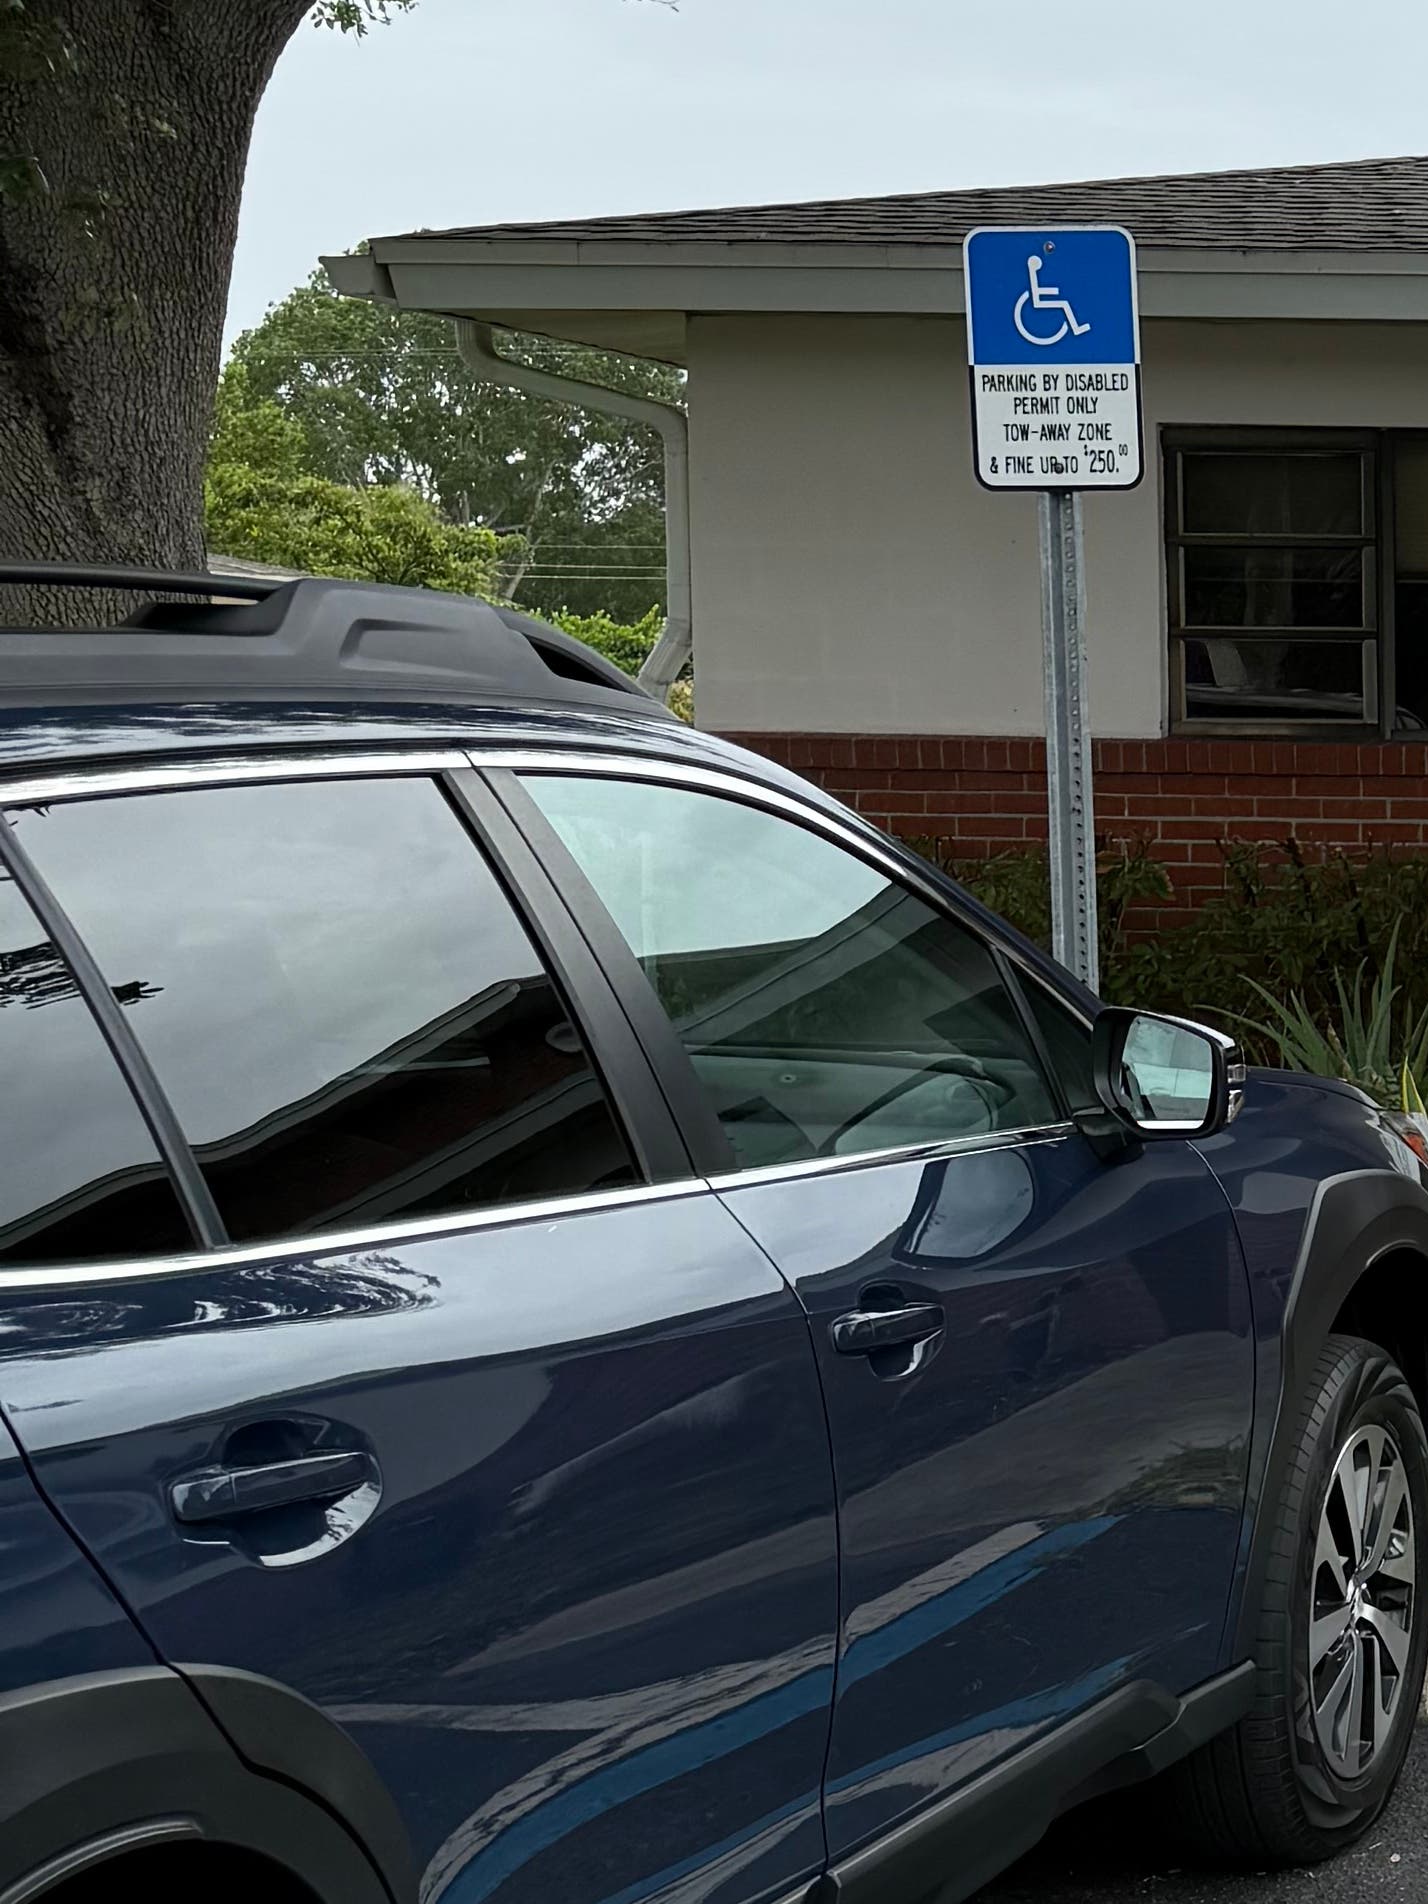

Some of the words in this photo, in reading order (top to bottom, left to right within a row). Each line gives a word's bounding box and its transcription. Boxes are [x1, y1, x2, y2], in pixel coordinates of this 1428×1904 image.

[982, 374, 1037, 392] PARKING
[1043, 374, 1059, 391] BY
[1065, 373, 1129, 391] DISABLED
[1013, 396, 1060, 415] PERMIT
[1066, 396, 1098, 414] ONLY
[1003, 423, 1071, 442] TOW-AWAY
[1077, 423, 1112, 441] ZONE
[990, 456, 998, 474] &
[1005, 456, 1034, 474] FINE
[1040, 456, 1057, 474] UP
[1063, 456, 1079, 474] TO
